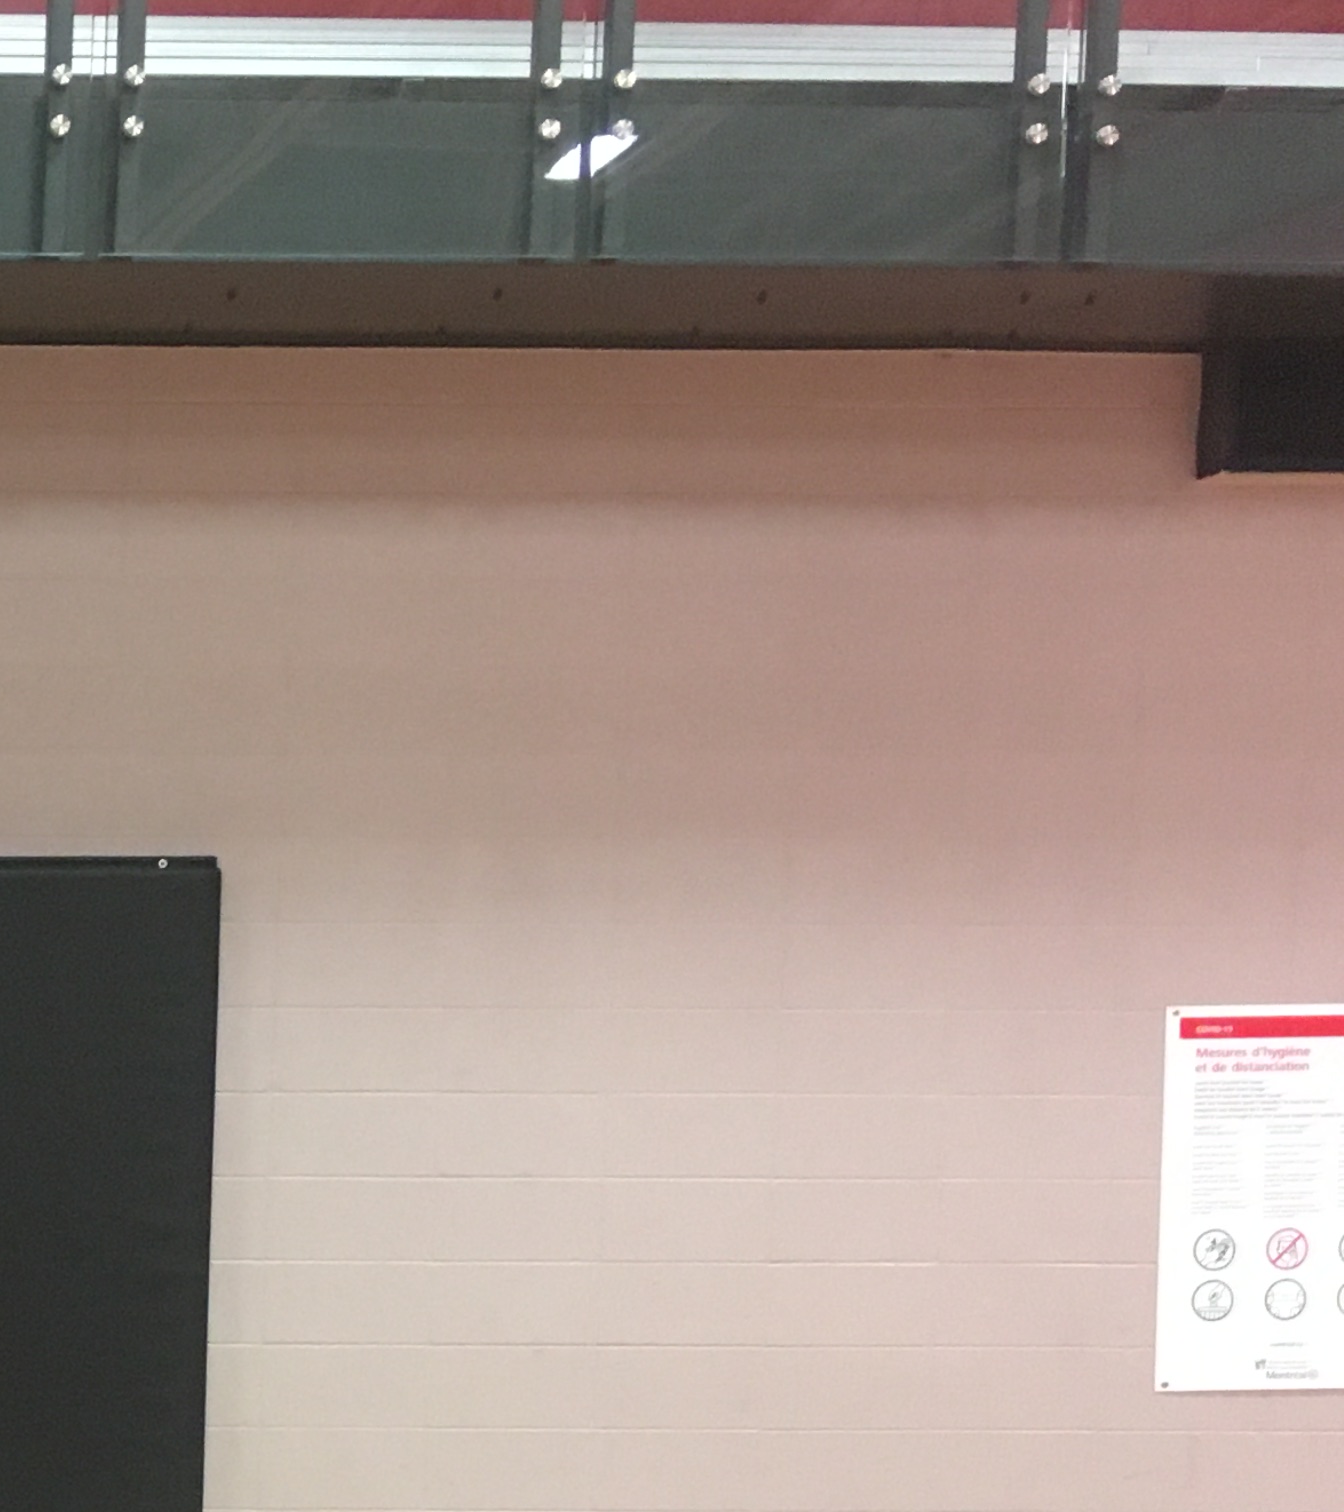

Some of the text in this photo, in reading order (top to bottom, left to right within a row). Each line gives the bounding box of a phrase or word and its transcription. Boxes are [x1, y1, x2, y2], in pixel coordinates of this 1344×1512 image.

[1195, 1047, 1248, 1058] Mesures
[1195, 1061, 1310, 1073] et de distanciation
